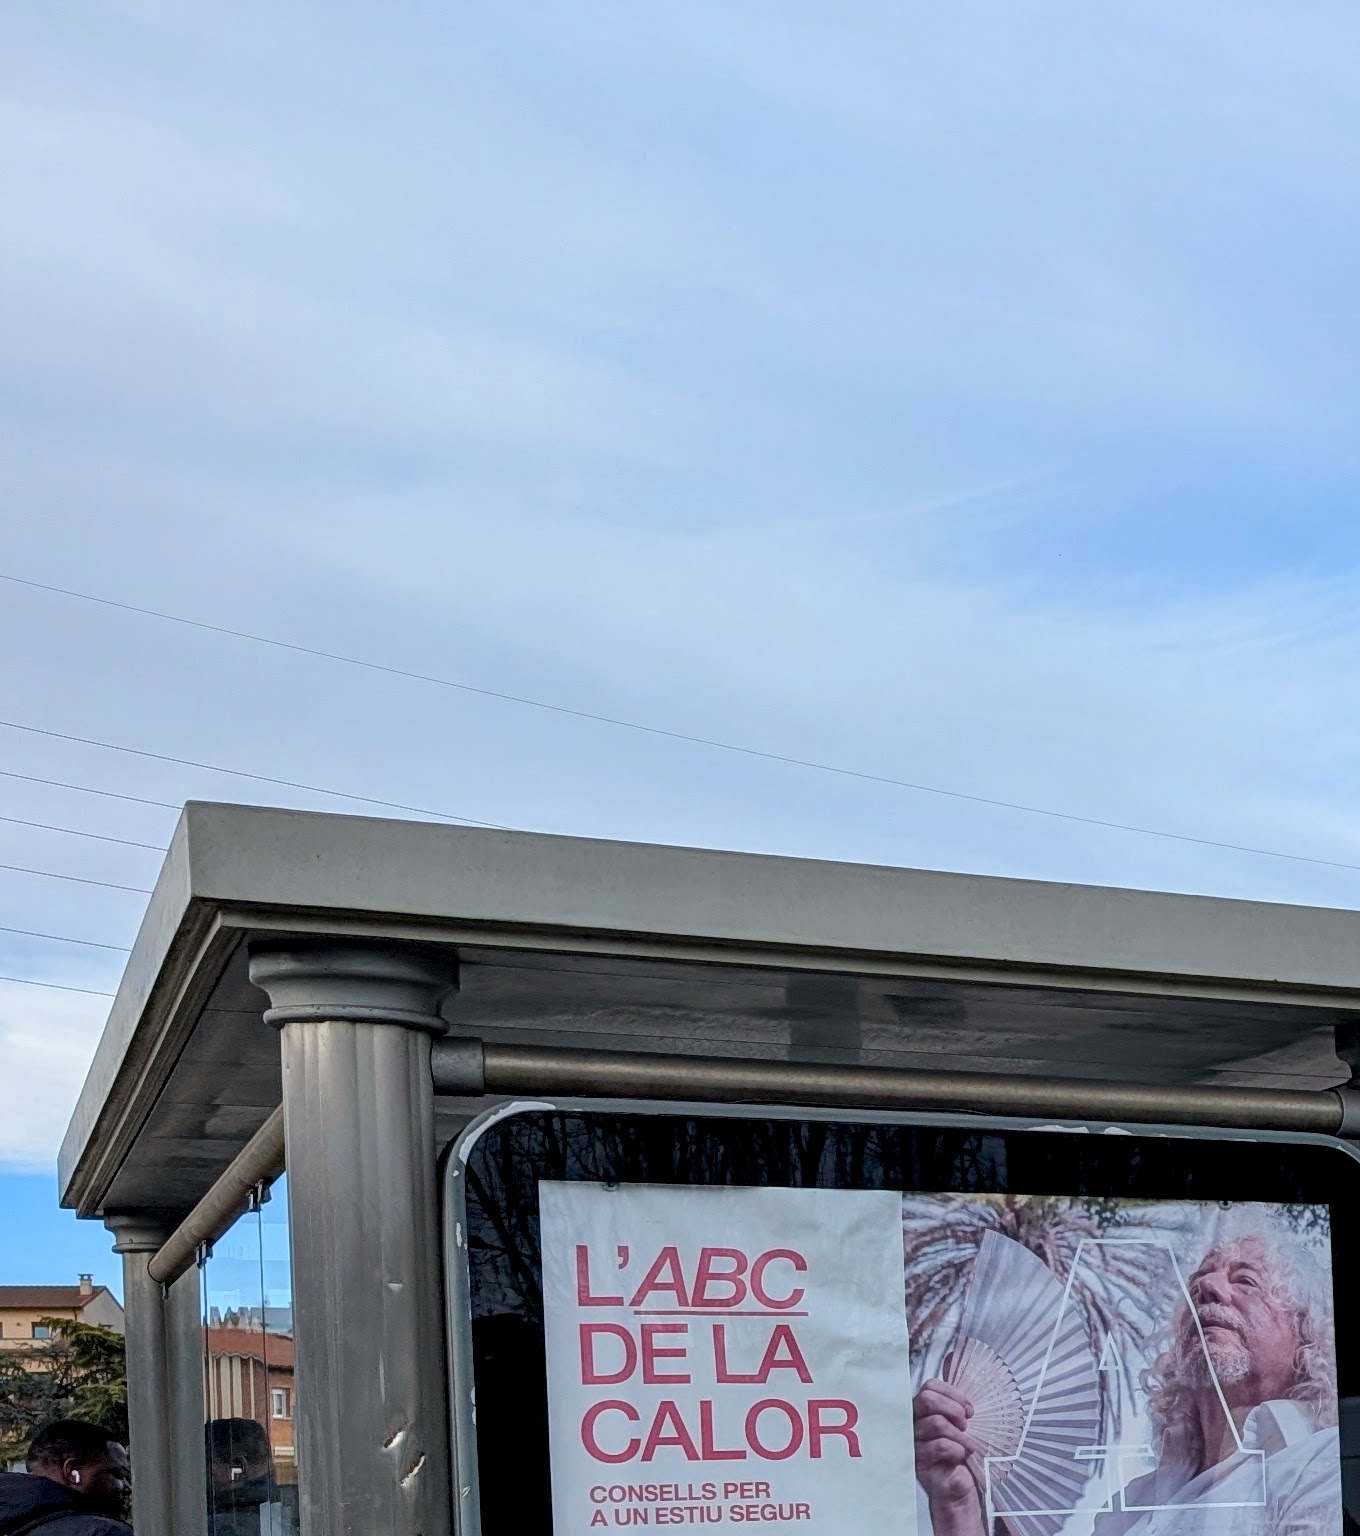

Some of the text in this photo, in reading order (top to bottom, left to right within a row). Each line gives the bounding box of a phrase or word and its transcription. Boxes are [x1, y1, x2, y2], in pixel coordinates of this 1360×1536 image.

[575, 1245, 808, 1310] L'ABC
[579, 1323, 814, 1385] DE LA
[581, 1398, 862, 1464] CALOR
[589, 1481, 771, 1504] CONSELLS PER
[590, 1503, 811, 1527] A UN ESTIU SEGUR
